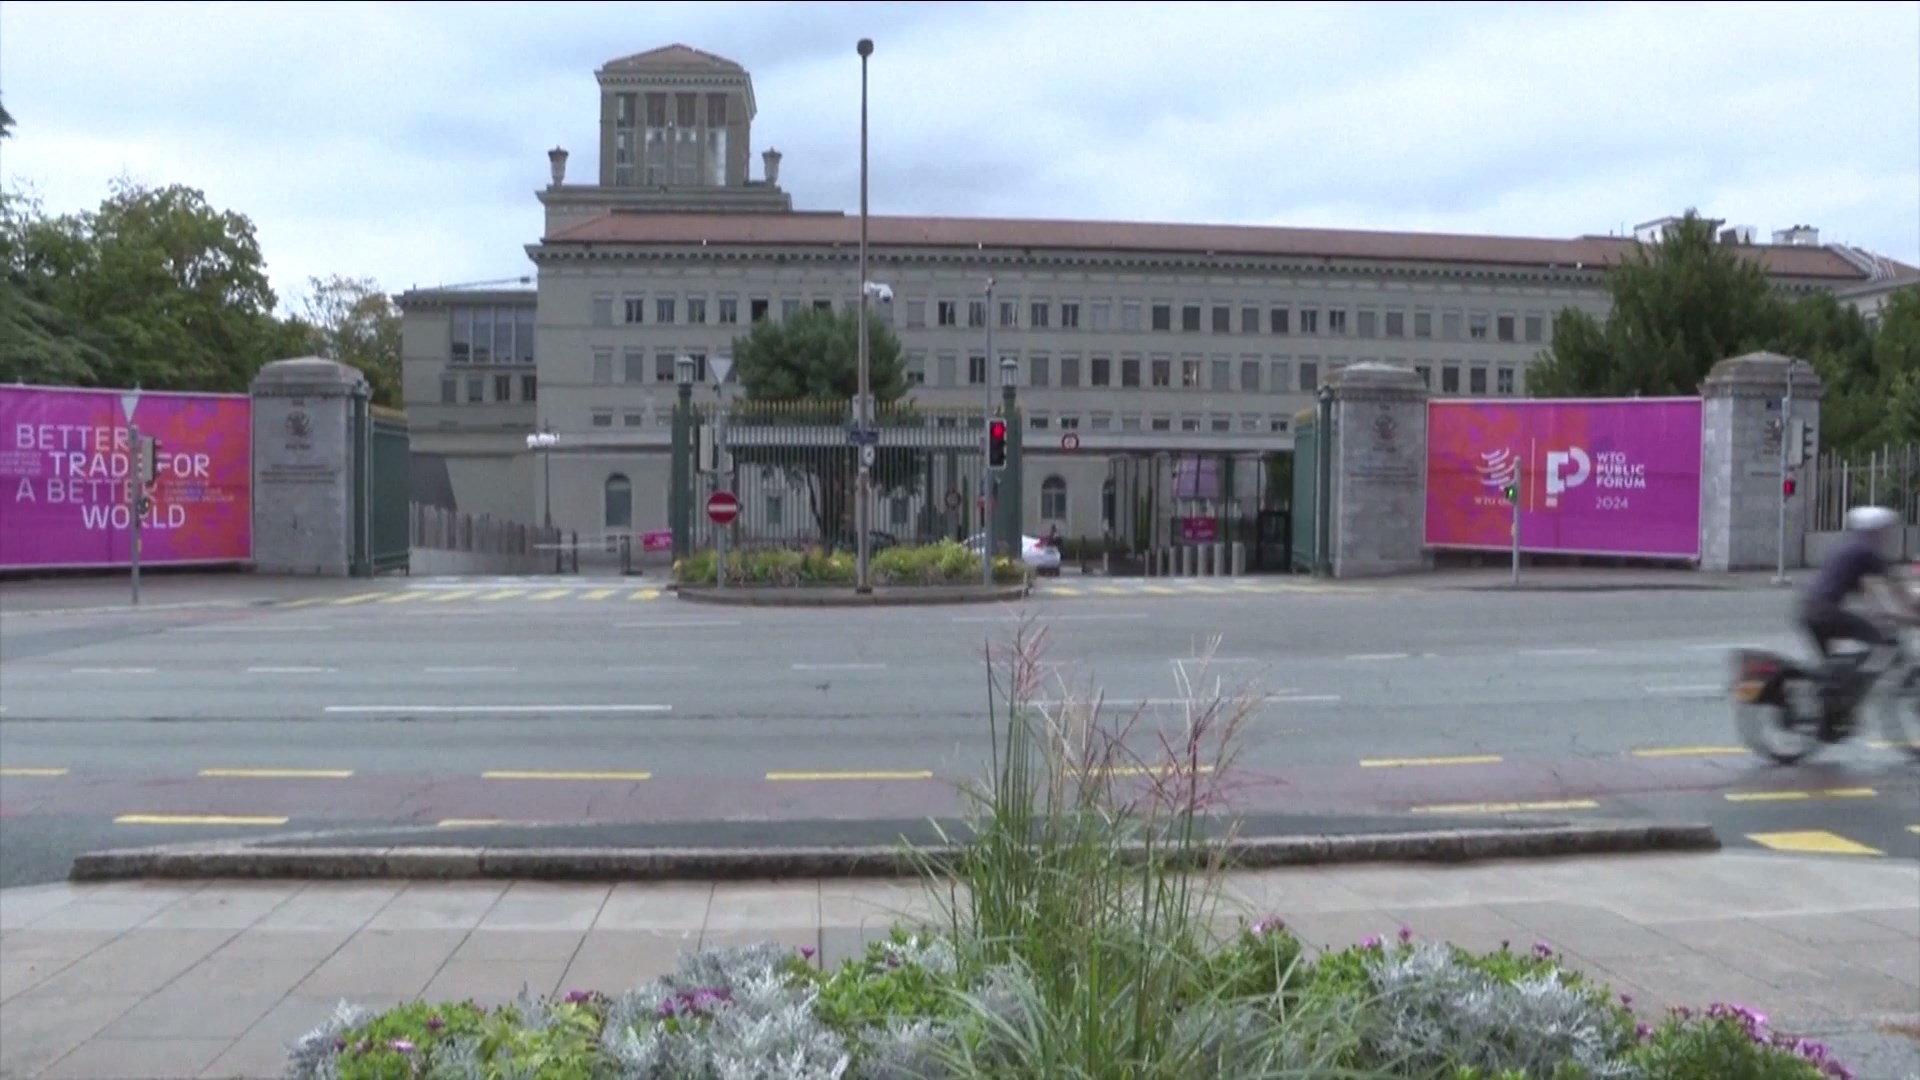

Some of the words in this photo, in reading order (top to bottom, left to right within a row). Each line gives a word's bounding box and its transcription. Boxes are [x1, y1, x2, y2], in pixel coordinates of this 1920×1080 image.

[16, 423, 130, 451] BETTER
[1596, 452, 1627, 464] WTO
[155, 453, 210, 478] FOR
[1596, 464, 1646, 476] PUBLIC
[1596, 475, 1646, 489] FORUM
[15, 477, 36, 503] A
[1595, 497, 1629, 510] 2024
